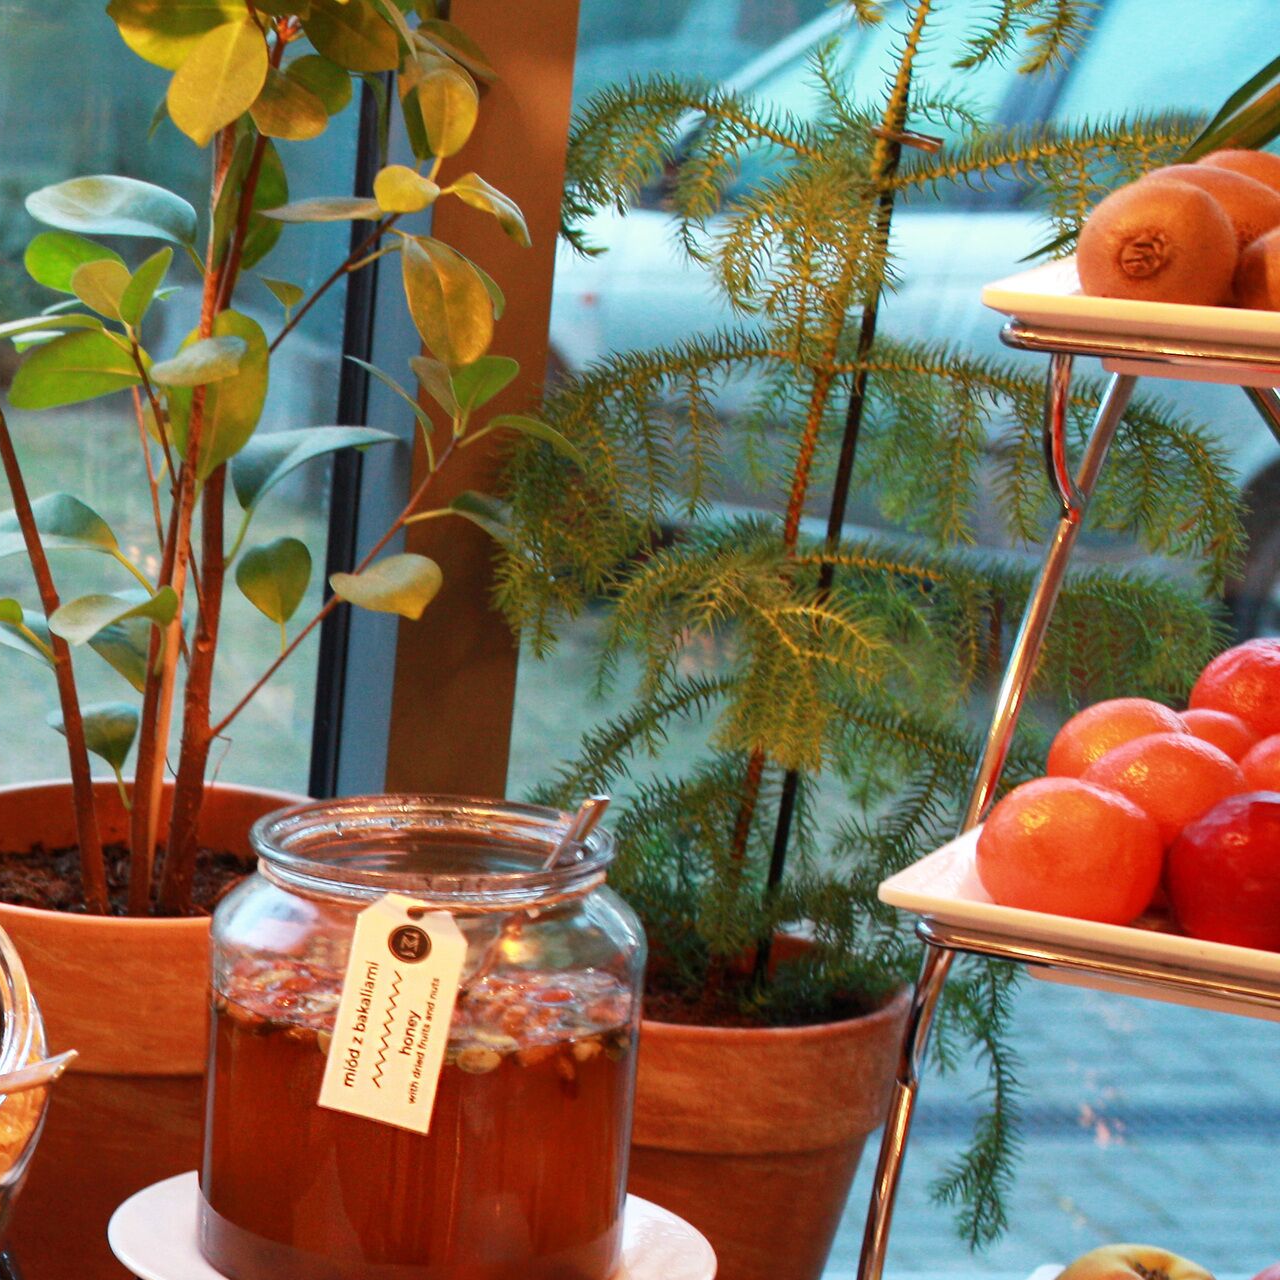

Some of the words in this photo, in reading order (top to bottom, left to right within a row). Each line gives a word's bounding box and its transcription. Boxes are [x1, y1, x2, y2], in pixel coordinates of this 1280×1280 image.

[353, 960, 380, 1034] bakaliami
[430, 977, 441, 1000] nuts
[426, 1001, 436, 1022] and
[352, 1034, 364, 1047] z
[399, 1010, 422, 1056] honey
[417, 1024, 431, 1050] fruits
[343, 1048, 361, 1088] miód
[412, 1052, 425, 1080] dried
[408, 1081, 420, 1105] with
